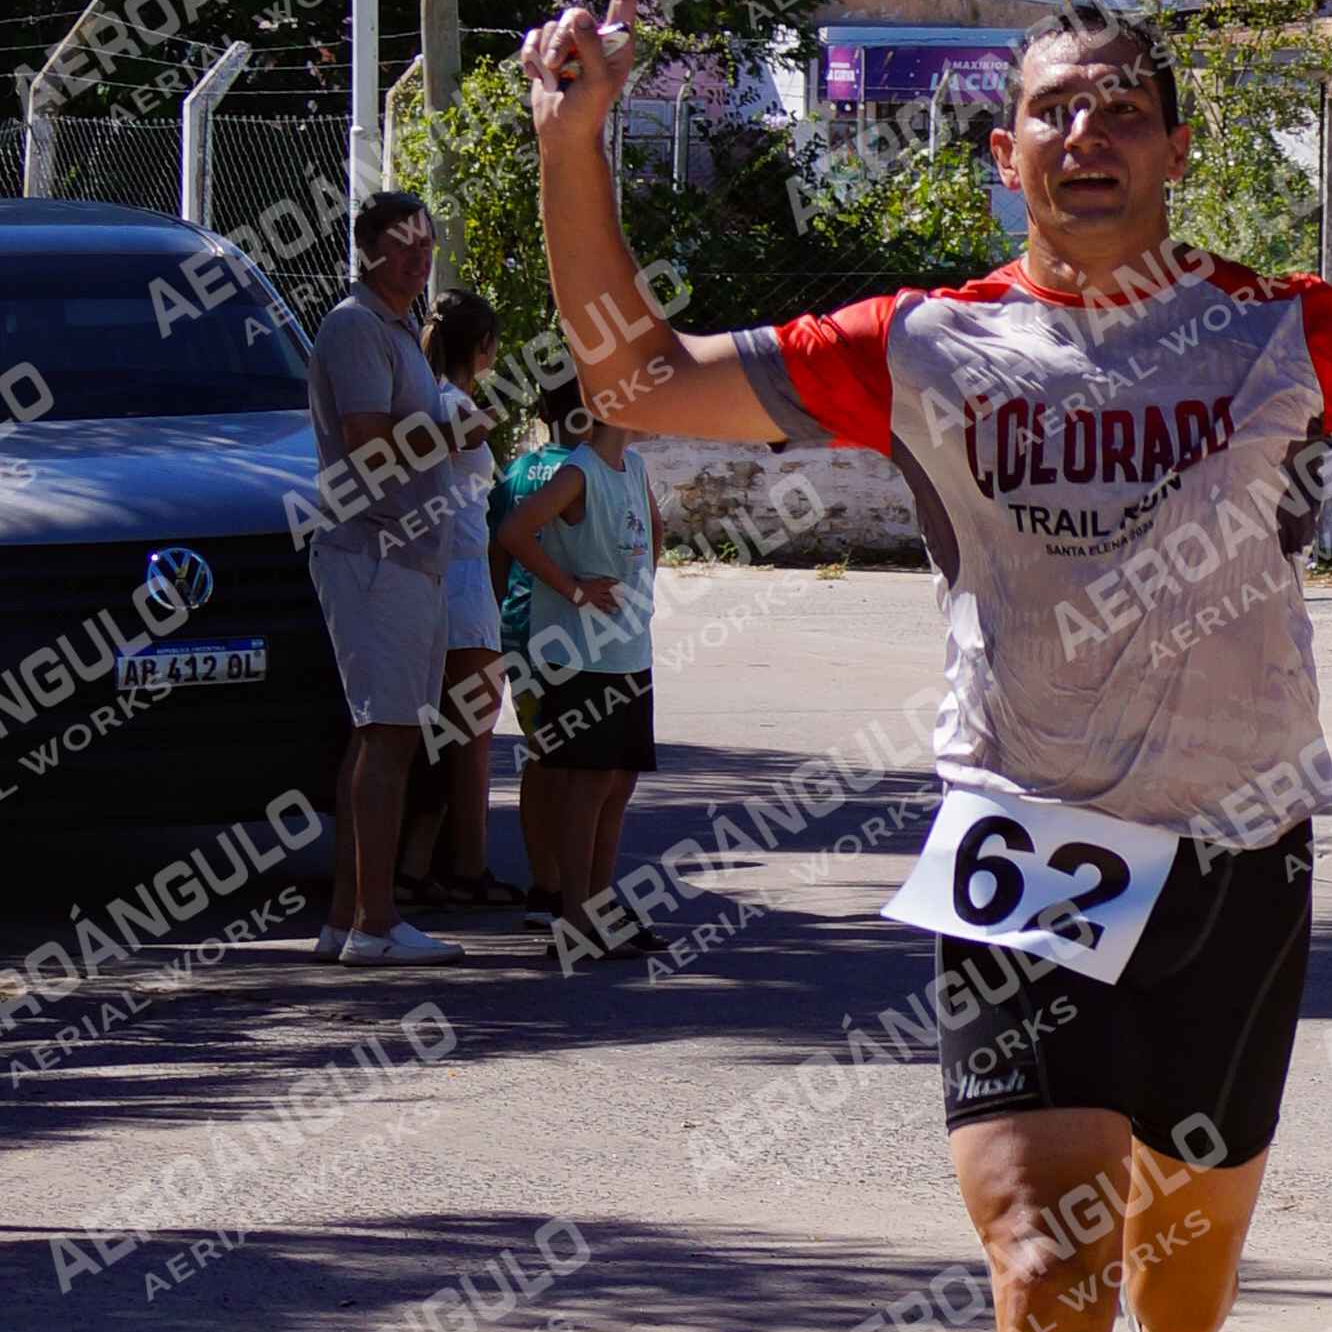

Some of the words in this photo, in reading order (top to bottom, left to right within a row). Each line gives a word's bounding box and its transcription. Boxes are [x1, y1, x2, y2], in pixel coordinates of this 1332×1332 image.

[963, 393, 1235, 500] COLORADO
[1008, 503, 1112, 538] TRAIL
[1045, 542, 1087, 556] SANTA
[167, 653, 217, 683] 412
[952, 815, 1131, 951] 62
